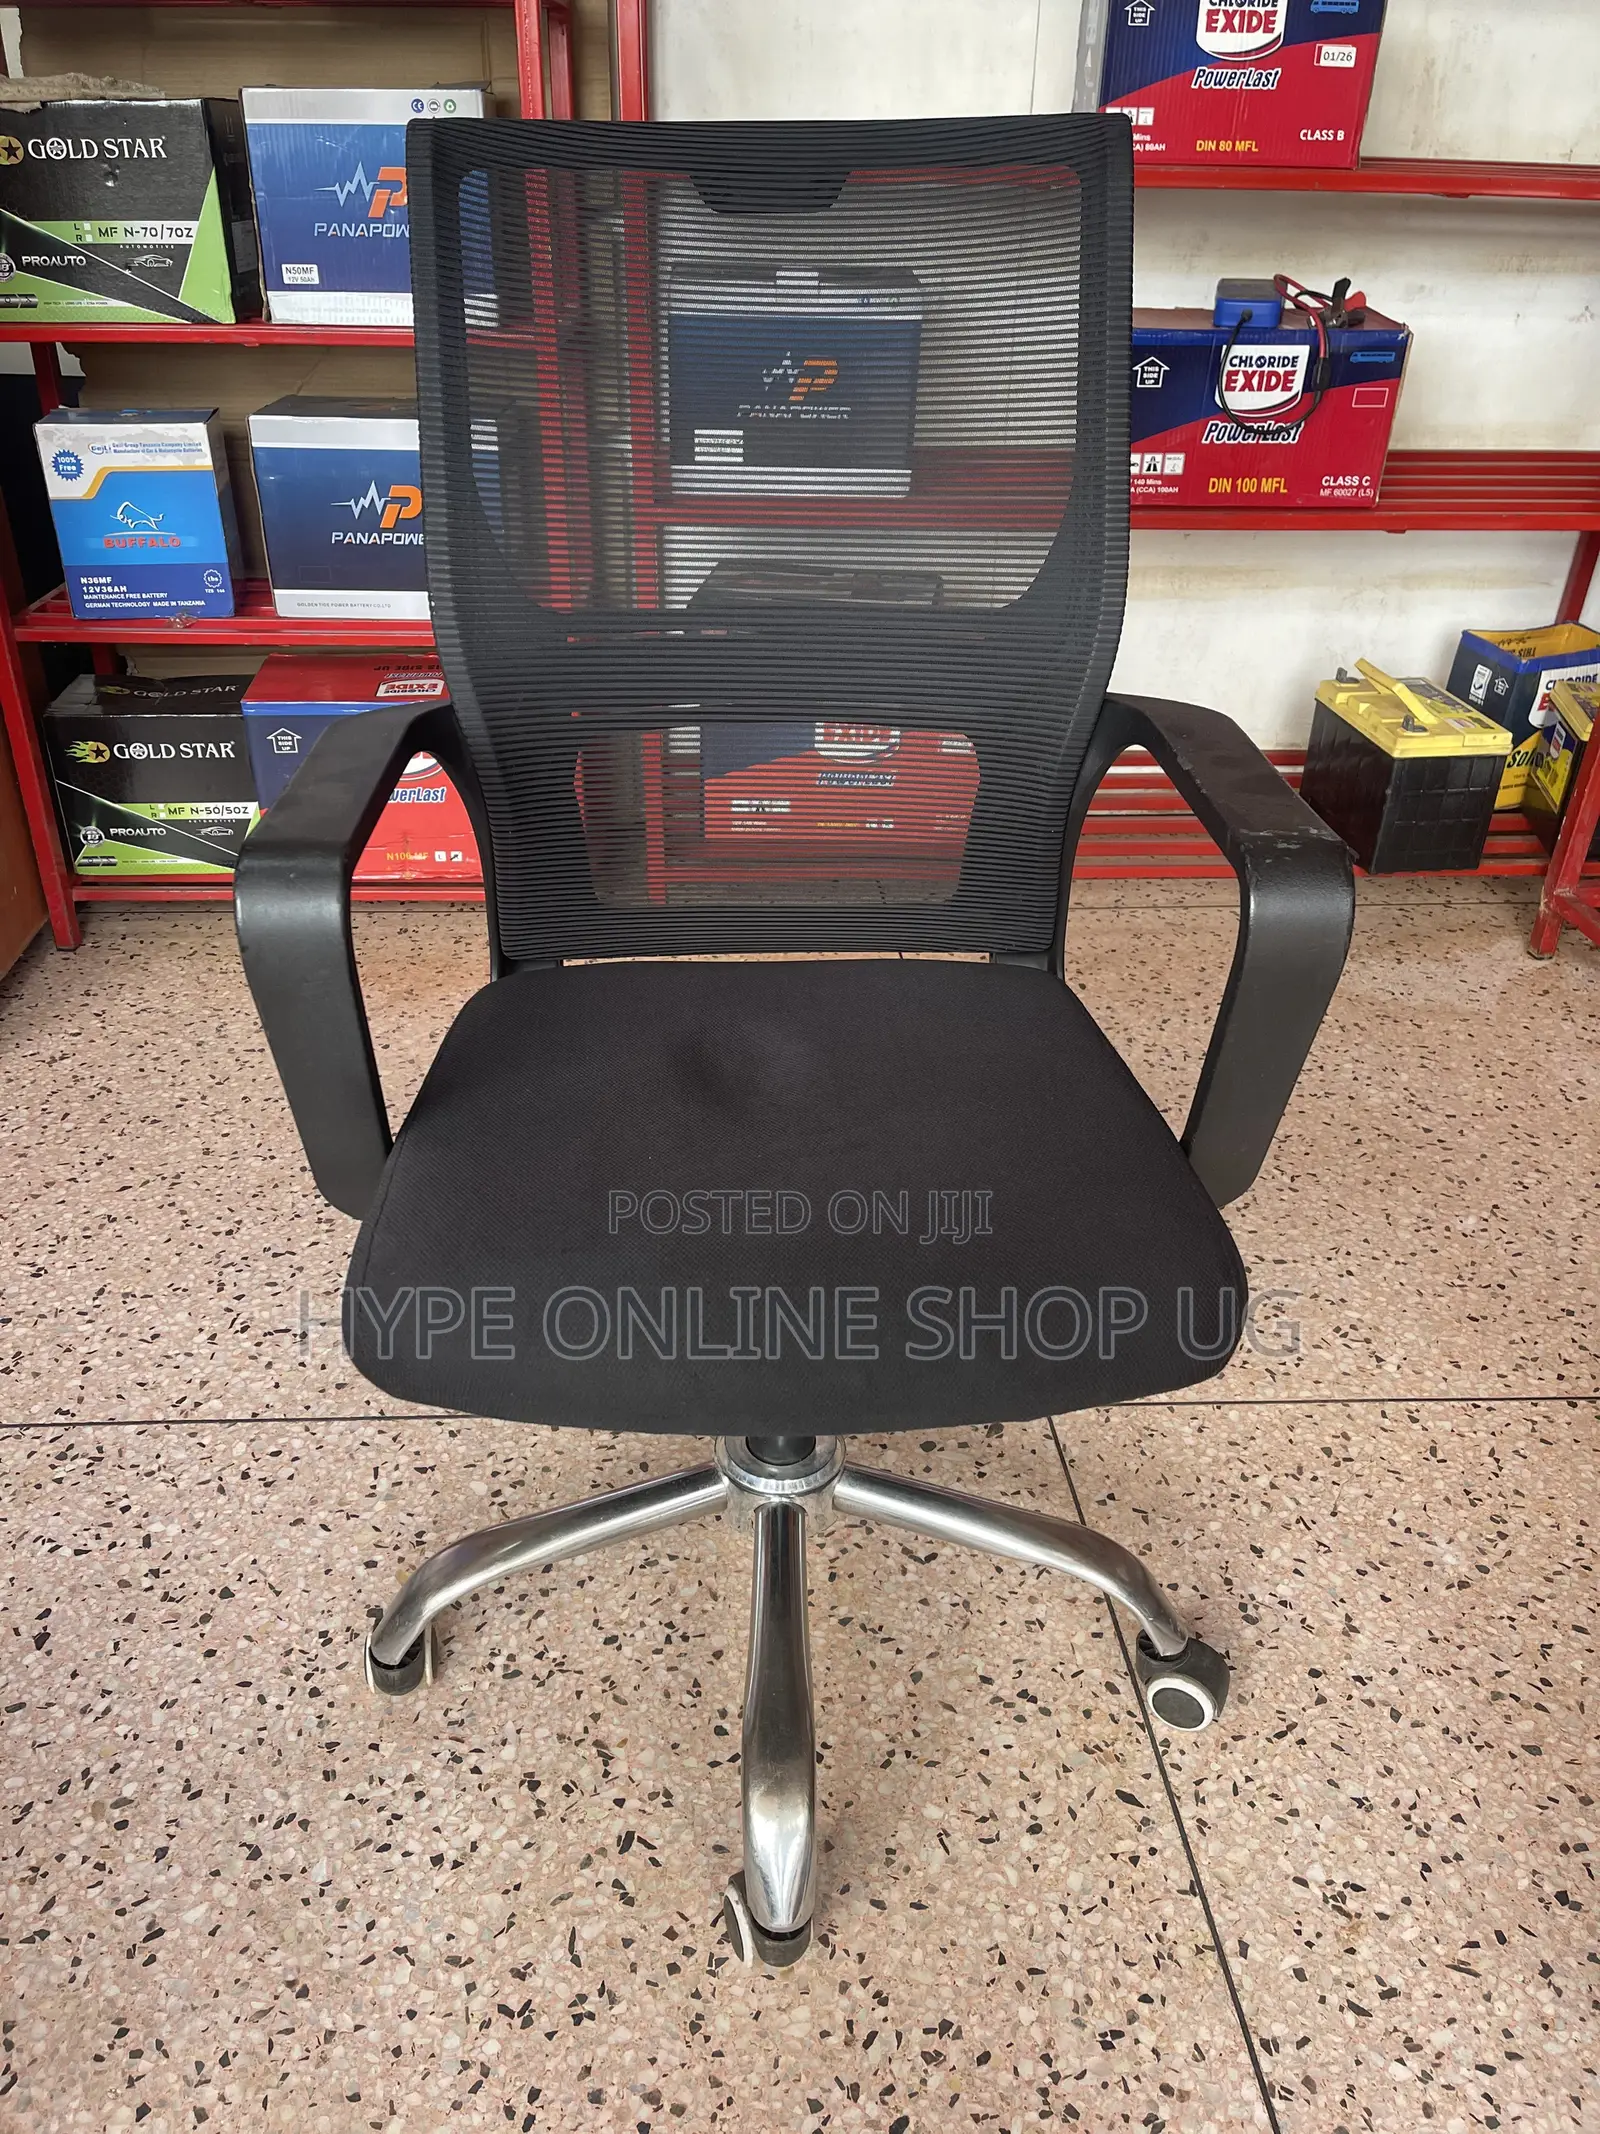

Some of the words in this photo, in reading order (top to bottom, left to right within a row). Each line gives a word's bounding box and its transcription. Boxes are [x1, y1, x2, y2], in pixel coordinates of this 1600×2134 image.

[1205, 9, 1278, 33] EXIDE
[1322, 50, 1353, 62] 01/26
[1192, 67, 1281, 89] PowerLast
[1300, 129, 1334, 141] CLASS
[1337, 130, 1345, 141] B
[28, 137, 98, 160] GOLD
[104, 138, 167, 159] STAR
[1196, 140, 1216, 151] DIN
[1219, 140, 1232, 151] 80
[1235, 141, 1259, 152] MFL
[74, 223, 80, 231] L
[98, 227, 118, 238] MF
[124, 224, 194, 240] N-70/70Z
[314, 222, 410, 238] PANAPOW
[76, 234, 83, 242] R
[285, 266, 315, 275] N50MF
[1229, 355, 1299, 368] CHLORIDE
[1224, 370, 1297, 392] EXIDE
[1208, 477, 1231, 493] DIN
[1236, 477, 1257, 493] 100
[1260, 477, 1288, 493] MFL
[1322, 475, 1359, 486] CLASS
[1362, 476, 1371, 486] C
[1320, 488, 1332, 496] MF
[103, 537, 181, 549] BUFFALO
[80, 577, 112, 585] N36MF
[83, 585, 127, 593] 12V36AH
[134, 690, 186, 698] GOLD
[190, 685, 238, 695] STAR
[113, 742, 176, 760] GOLD
[180, 743, 235, 759] STAR
[168, 806, 185, 815] MF
[190, 805, 250, 817] N-50/50Z
